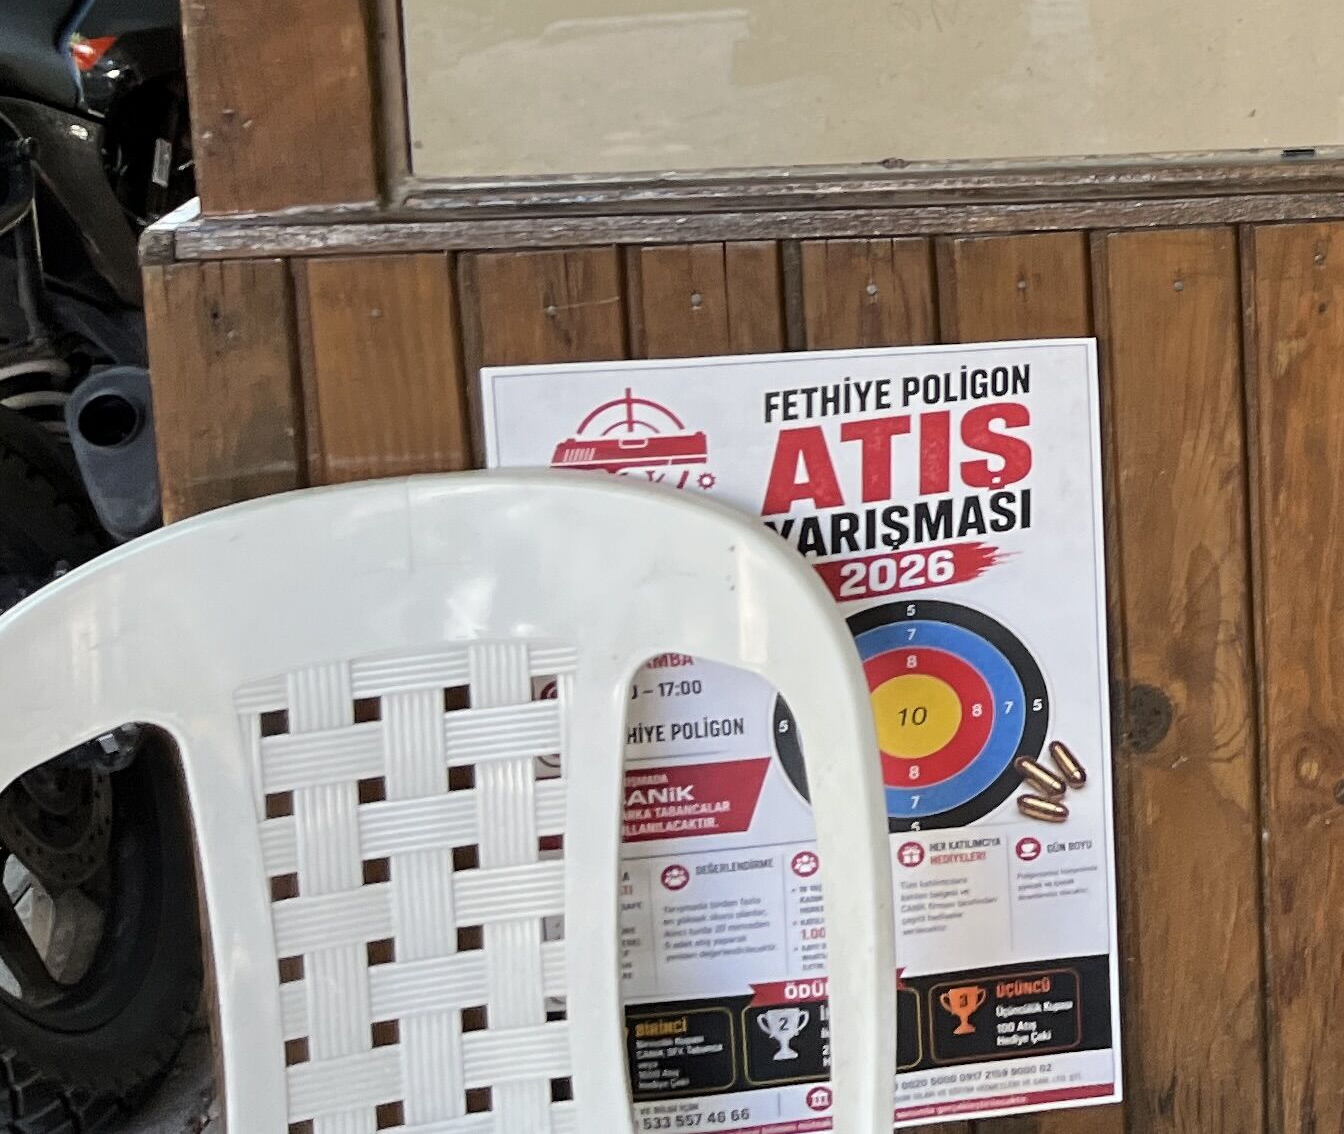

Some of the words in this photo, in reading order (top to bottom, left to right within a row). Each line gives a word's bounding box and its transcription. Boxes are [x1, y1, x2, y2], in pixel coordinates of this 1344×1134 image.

[764, 376, 892, 424] FETHİYE
[902, 363, 1031, 408] POLİGON
[760, 402, 1033, 517] ATIŞ
[763, 487, 1032, 558] YARIŞMASI
[839, 549, 955, 597] 2026
[906, 604, 916, 616] 5
[907, 628, 916, 641] 7
[906, 654, 918, 668] 8
[657, 679, 702, 698] 17:00
[971, 703, 983, 717] 8
[1004, 701, 1014, 714] 7
[1032, 698, 1043, 712] 5
[898, 706, 927, 726] 10
[626, 723, 666, 745] HİYE
[671, 717, 745, 742] POLİGON
[778, 719, 789, 733] 5
[908, 766, 920, 779] 8
[624, 784, 695, 807] ANiK
[910, 795, 921, 809] 7
[995, 976, 1052, 999] ÜÇÜNCÜ
[777, 1017, 789, 1031] 2
[642, 1117, 672, 1131] 533
[675, 1113, 703, 1127] 557
[730, 1108, 750, 1120] 66
